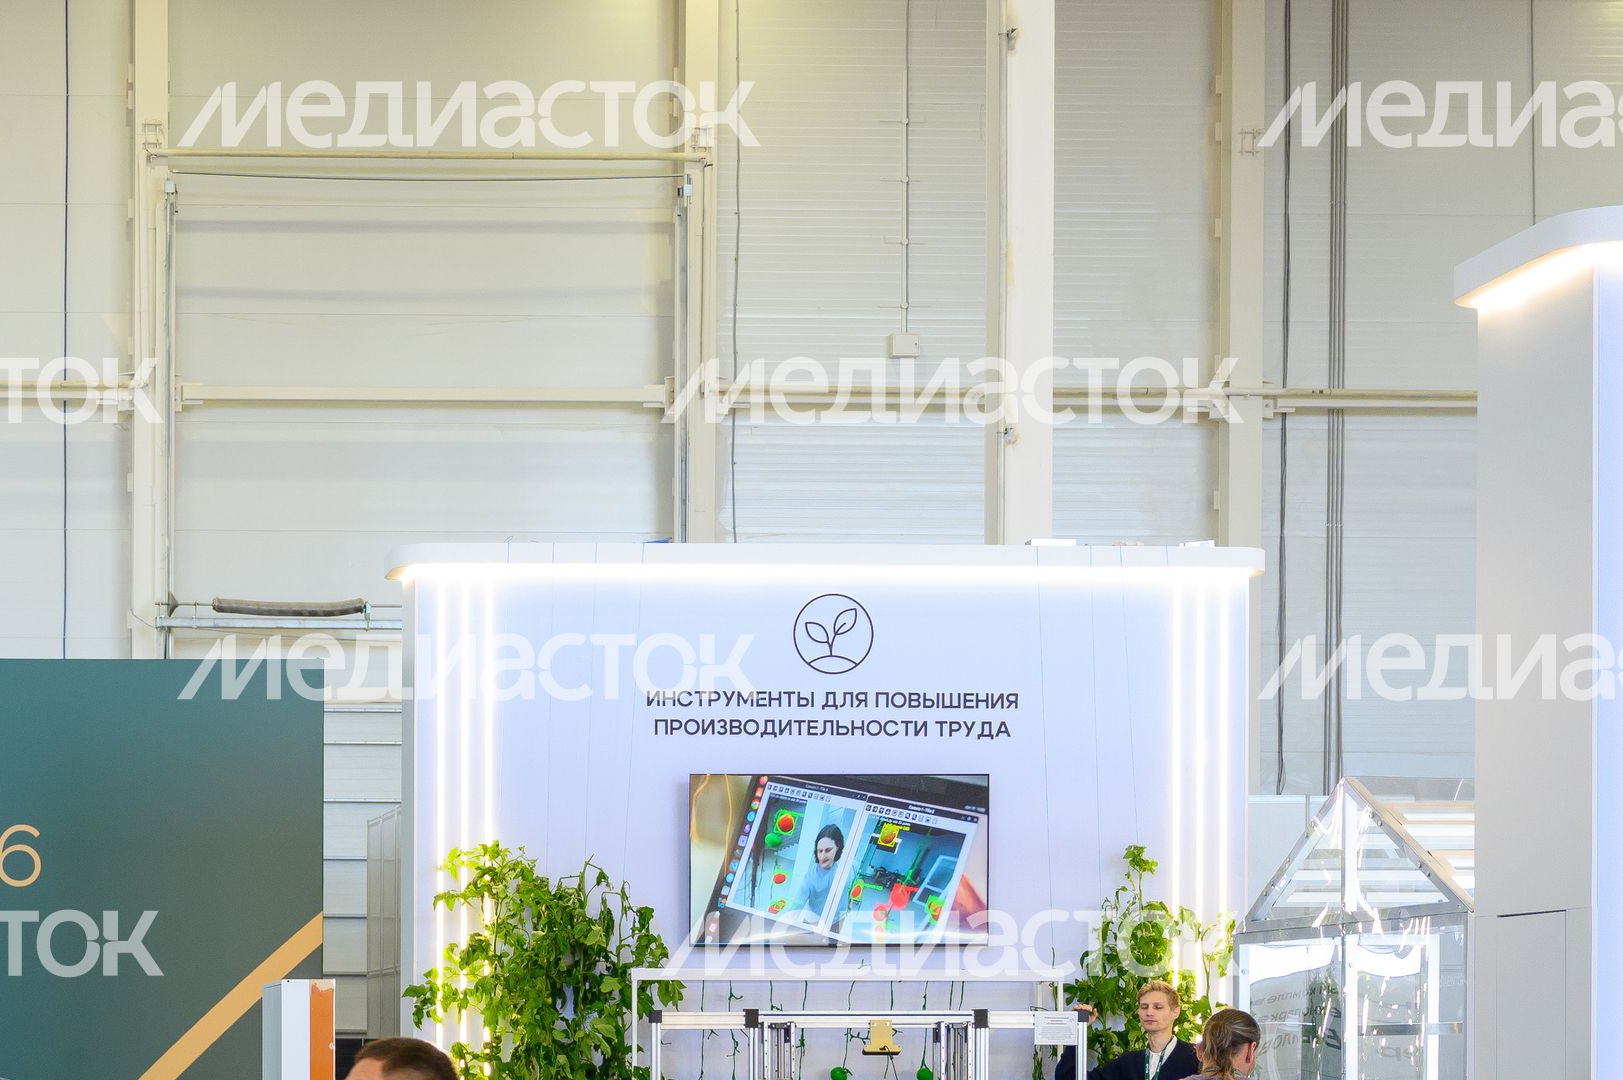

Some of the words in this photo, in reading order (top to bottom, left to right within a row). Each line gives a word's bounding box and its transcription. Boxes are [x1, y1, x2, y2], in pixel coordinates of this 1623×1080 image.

[645, 690, 816, 708] ИНСТРУМЕНТЫ
[821, 691, 869, 710] ДЛЯ
[874, 691, 1020, 710] ПОВЫШЕНИЯ
[653, 718, 928, 738] ПРОИЗВОДИТЕЛЬНОСТИ
[934, 719, 1012, 740] ТРУДА
